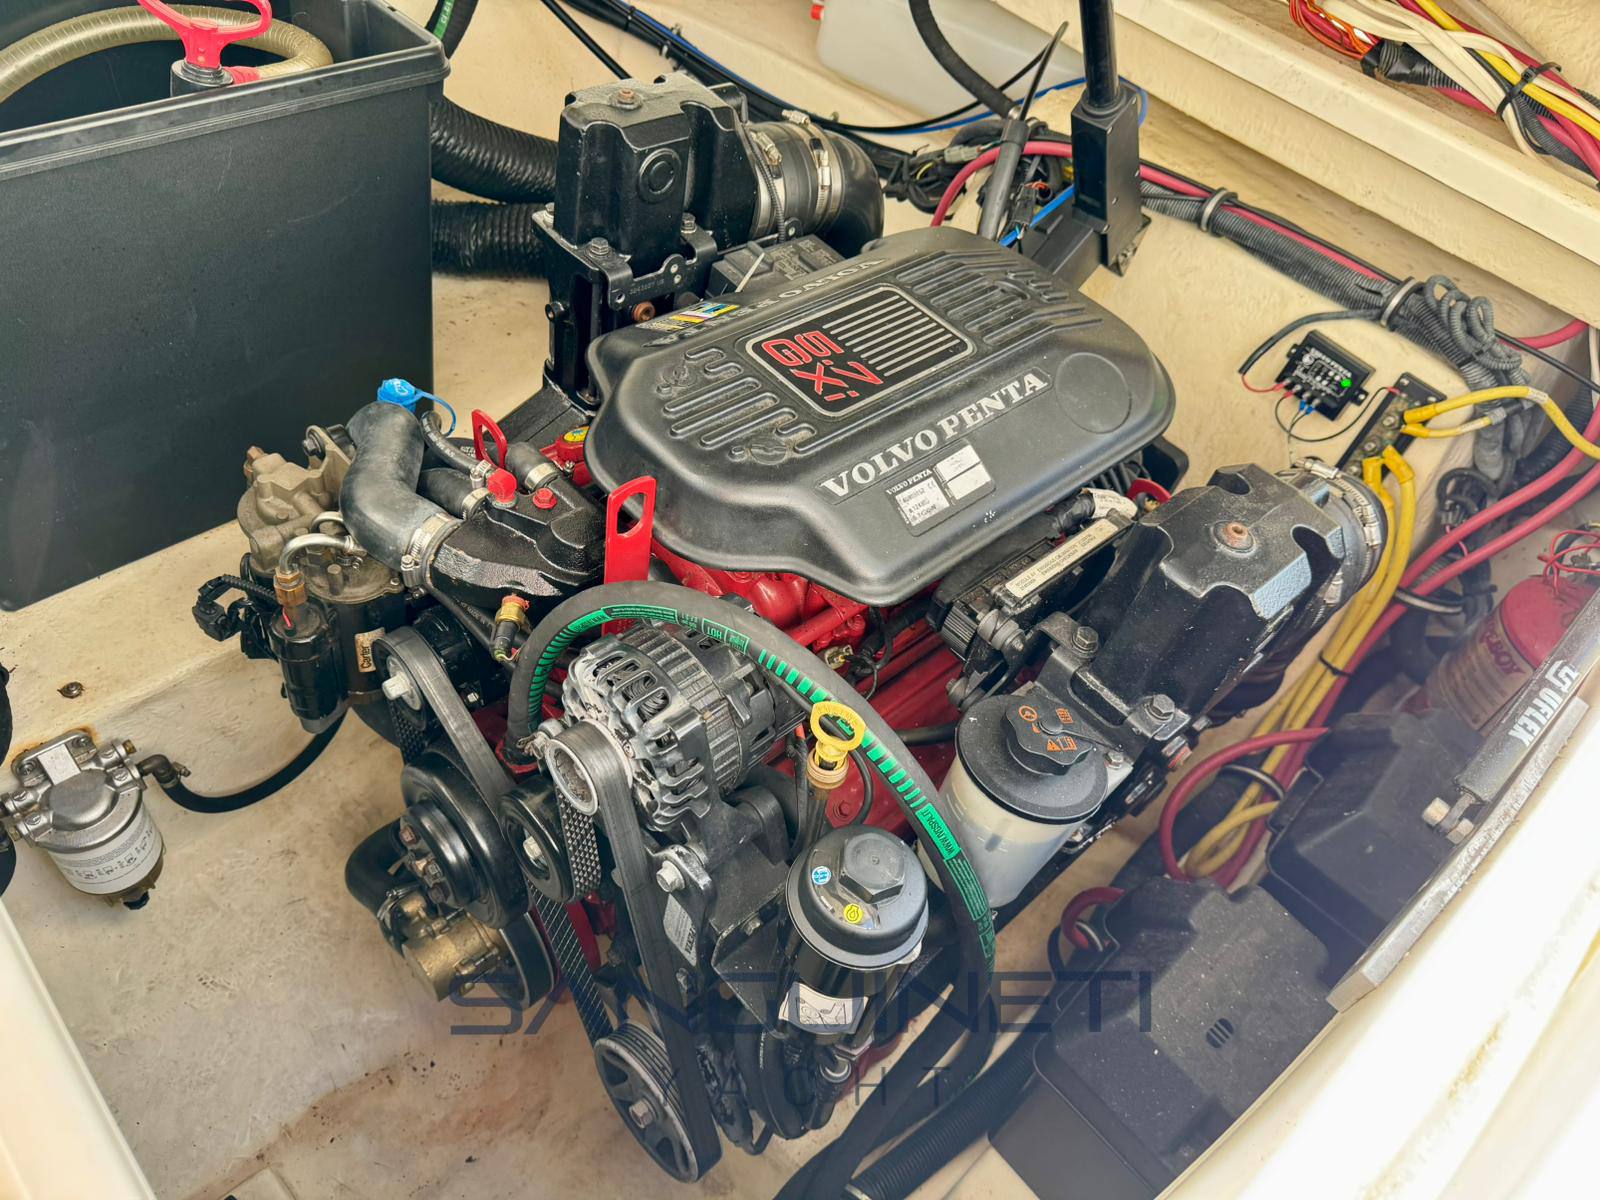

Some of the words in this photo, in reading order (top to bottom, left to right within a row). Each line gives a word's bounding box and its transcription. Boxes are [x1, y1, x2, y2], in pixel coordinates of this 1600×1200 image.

[761, 338, 860, 401] GXi
[794, 330, 884, 385] 5.7
[820, 429, 938, 497] VOLVO
[937, 372, 1049, 440] PENTA
[886, 480, 908, 495] VOLVO
[907, 468, 933, 485] PENTA
[360, 645, 372, 668] Carter
[1508, 687, 1563, 747] UFLEX
